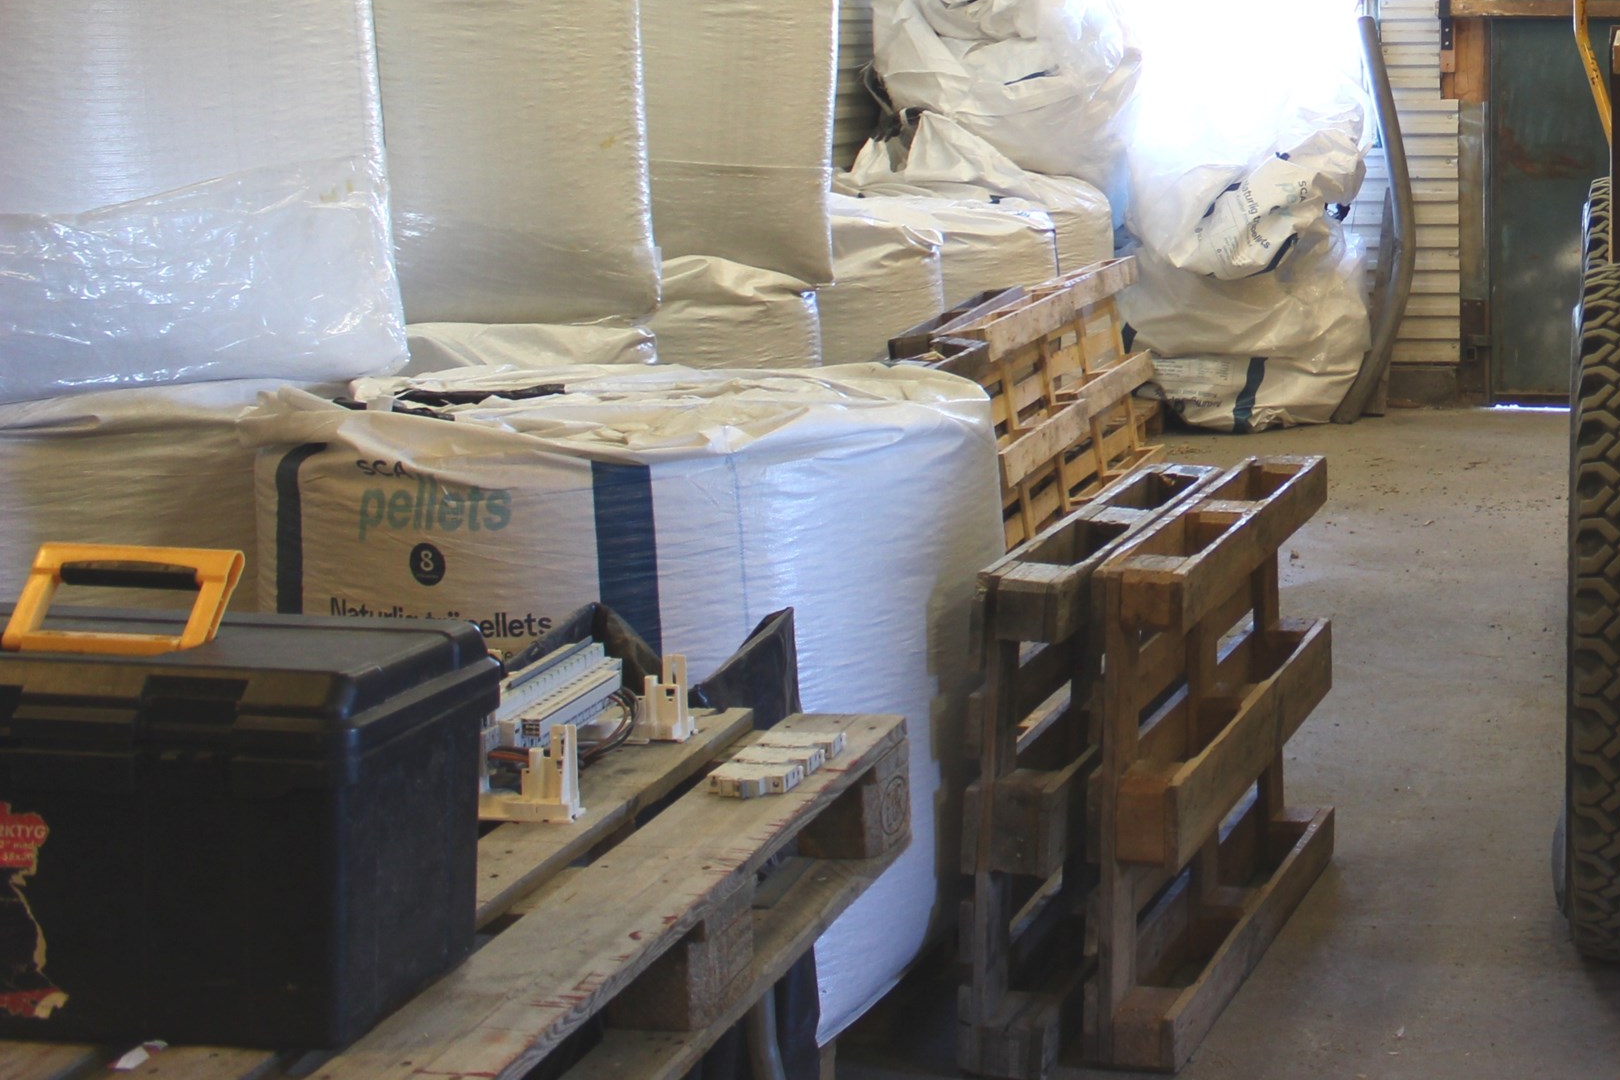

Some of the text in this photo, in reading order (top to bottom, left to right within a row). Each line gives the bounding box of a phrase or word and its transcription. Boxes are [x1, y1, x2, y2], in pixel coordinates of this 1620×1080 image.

[356, 459, 416, 480] SCA
[358, 473, 513, 543] pellets
[419, 550, 434, 571] 8
[330, 597, 418, 619] Naturli
